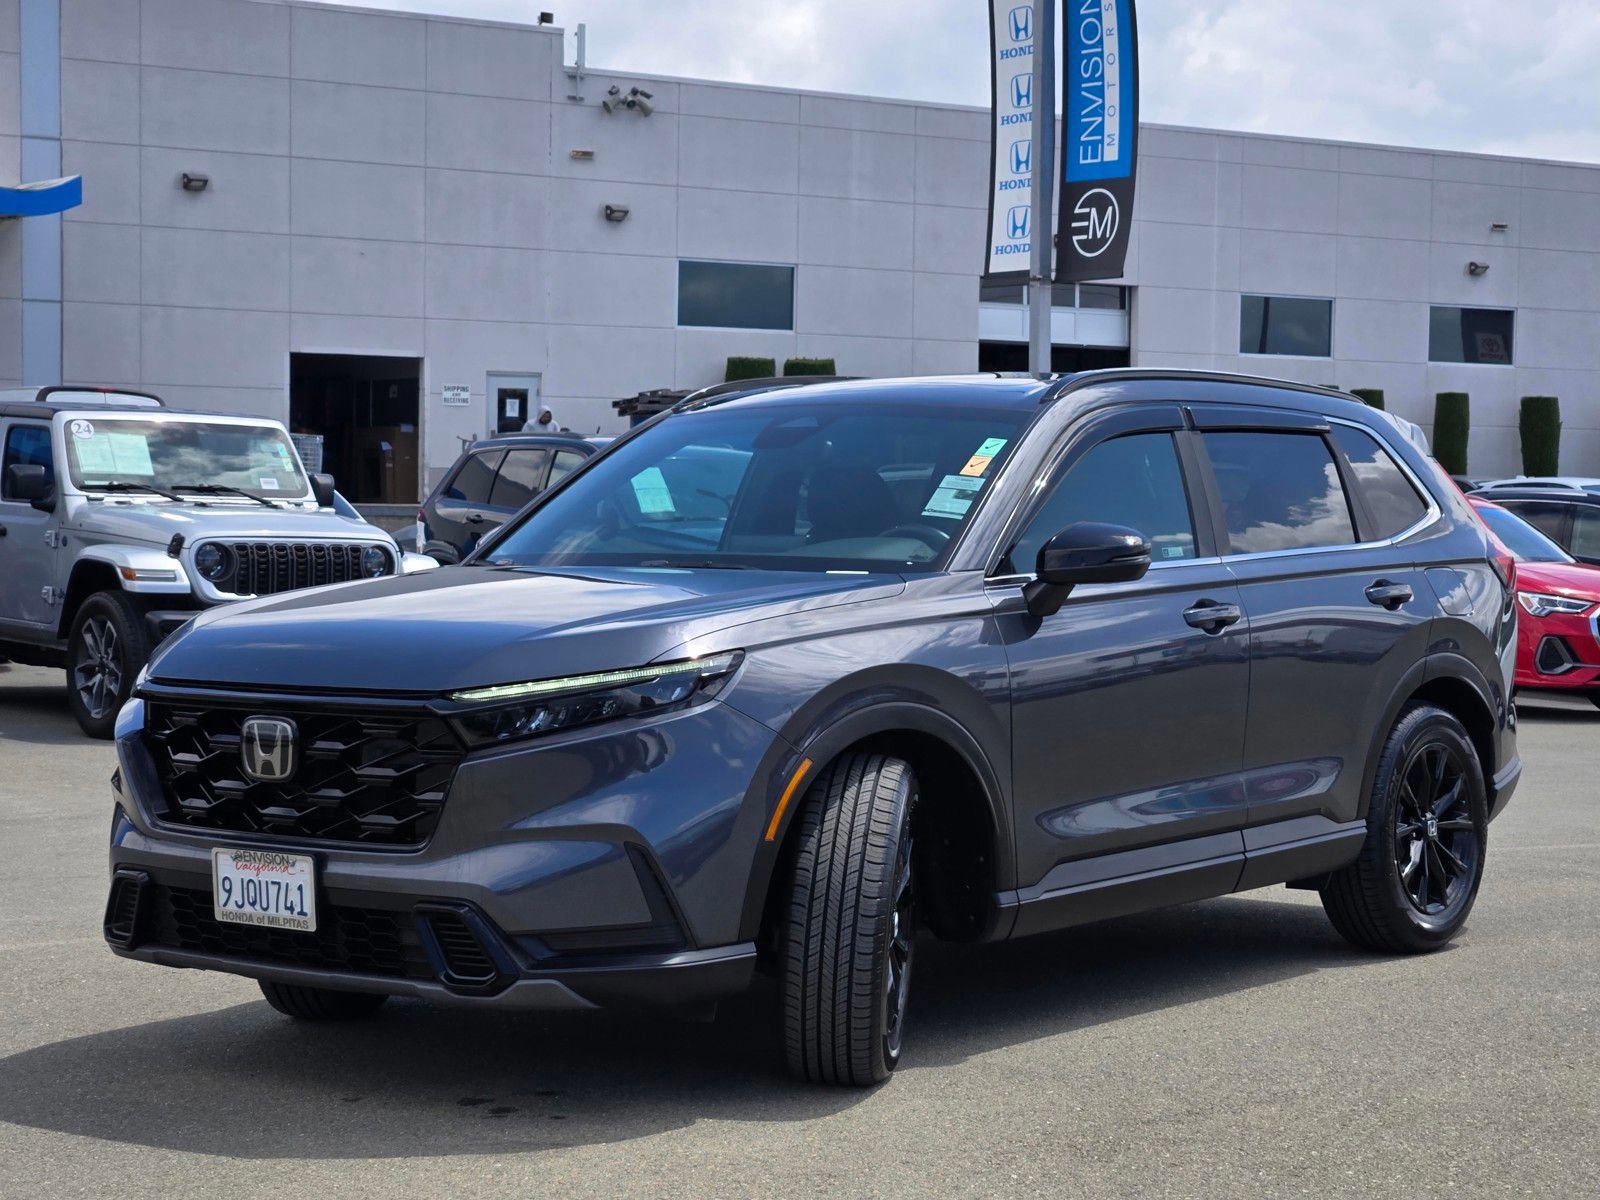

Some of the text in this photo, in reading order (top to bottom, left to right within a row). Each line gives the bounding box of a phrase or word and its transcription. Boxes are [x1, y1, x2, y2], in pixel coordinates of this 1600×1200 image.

[1000, 45, 1034, 60] HOND
[1080, 0, 1103, 164] ENVISION
[1104, 3, 1117, 146] MOTORS
[1000, 112, 1032, 125] HON
[999, 178, 1032, 190] HON
[995, 243, 1032, 255] HOND
[73, 423, 92, 435] 24
[243, 851, 289, 866] ENVISION
[222, 876, 308, 917] 9JQU741
[221, 911, 309, 929] HONDA of MILPITAS
